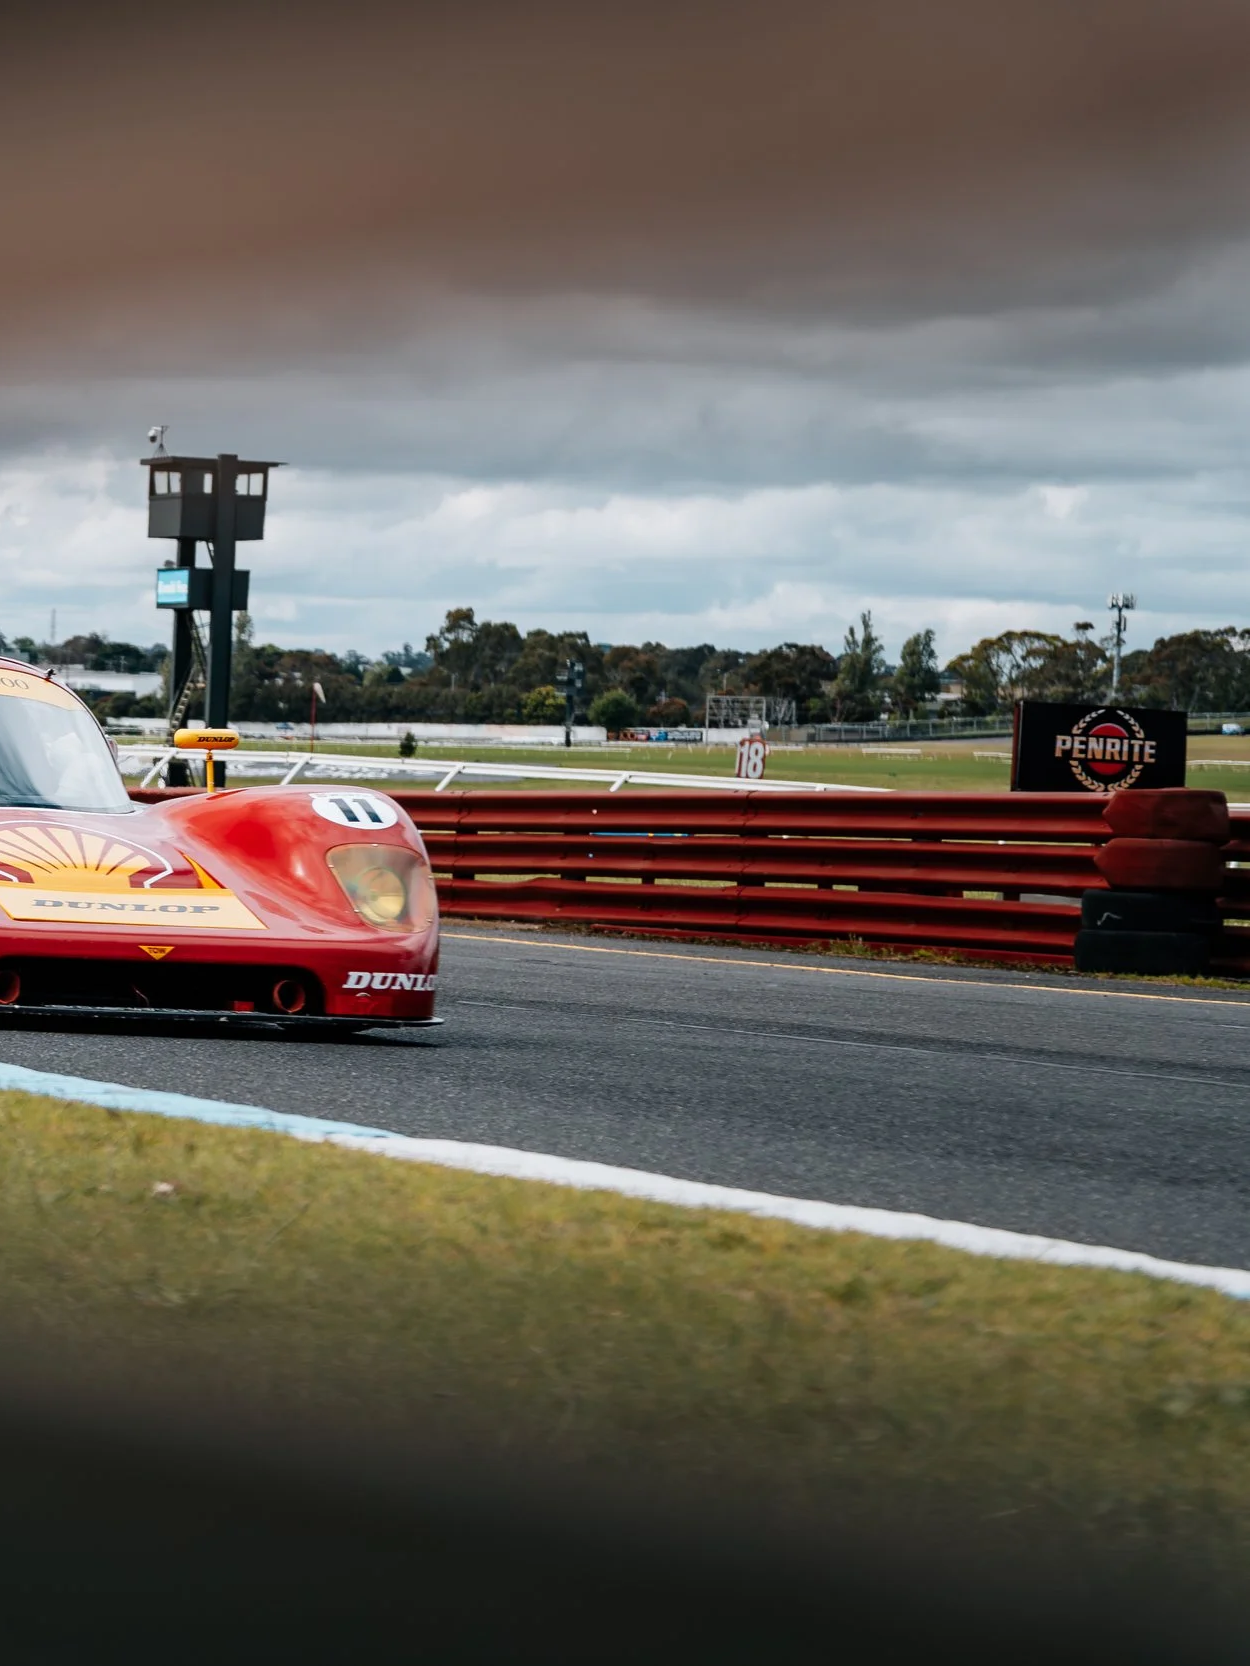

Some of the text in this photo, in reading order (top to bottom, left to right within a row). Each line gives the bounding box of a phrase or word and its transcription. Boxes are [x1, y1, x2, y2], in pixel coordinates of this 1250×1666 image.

[197, 735, 236, 743] DUNLOP
[1054, 735, 1157, 764] PENRITE
[738, 742, 764, 778] 18
[329, 798, 384, 823] 11
[31, 899, 220, 913] DUNLOP
